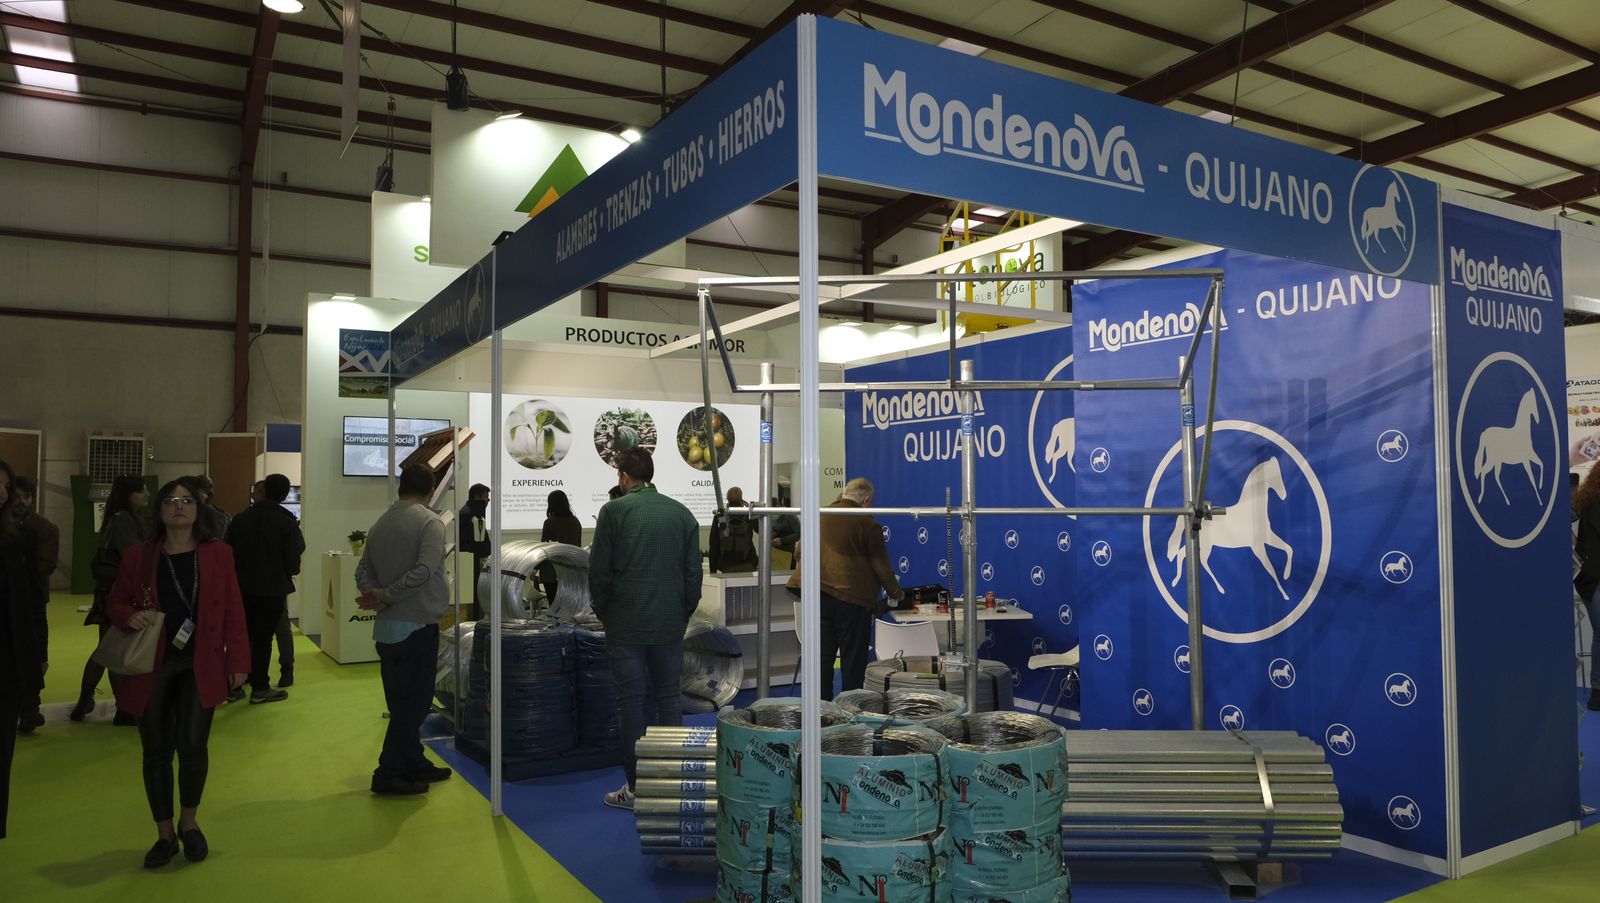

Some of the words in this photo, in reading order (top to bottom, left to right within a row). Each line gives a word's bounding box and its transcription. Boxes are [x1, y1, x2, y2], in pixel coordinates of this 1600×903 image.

[556, 207, 597, 264] ALAMBRES
[606, 170, 652, 232] TRENZAS
[663, 134, 704, 198] TUBOS
[719, 79, 785, 165] HIERROS
[1185, 152, 1333, 224] QUIJANO
[1255, 273, 1402, 319] QUIJANO
[1466, 296, 1543, 335] QUIJANO
[565, 326, 668, 348] PRODUCTOS
[512, 479, 564, 488] EXPERIENCIA
[856, 766, 908, 798] ALUMINIO
[976, 762, 1024, 790] ALUMINIO
